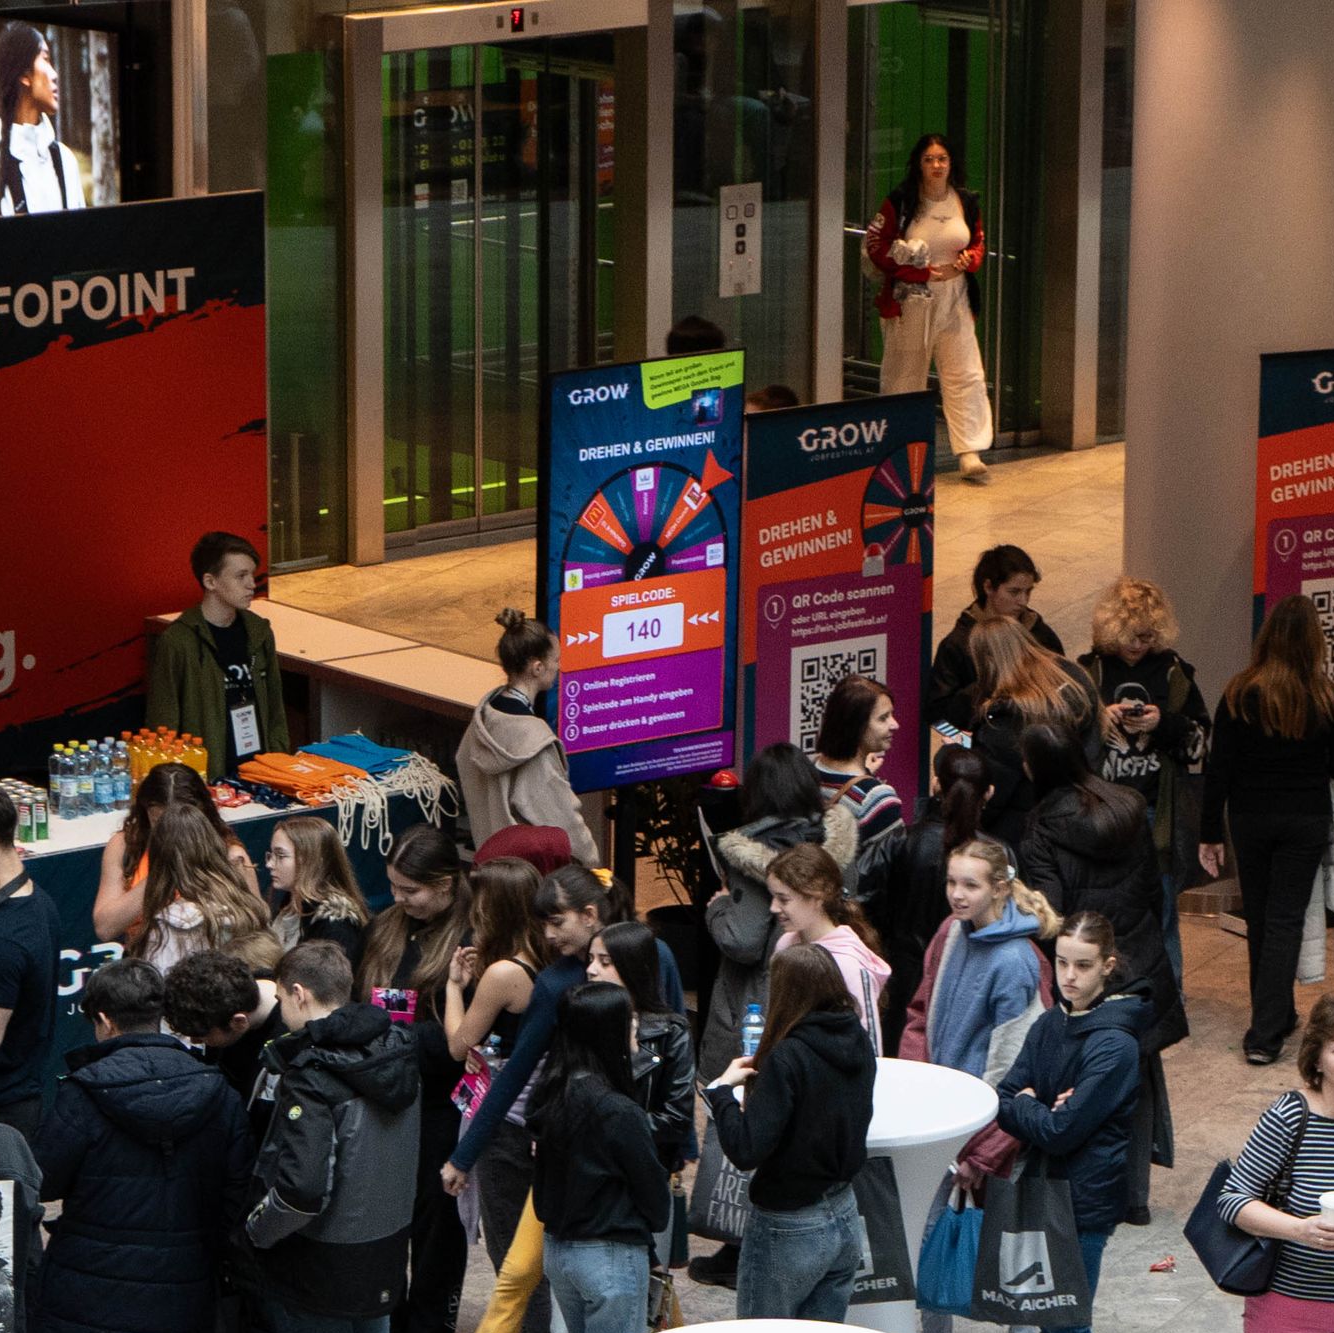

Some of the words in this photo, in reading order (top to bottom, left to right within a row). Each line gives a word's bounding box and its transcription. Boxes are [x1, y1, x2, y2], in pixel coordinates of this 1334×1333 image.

[568, 383, 629, 405] GROW
[579, 443, 631, 462] DREHEN
[633, 441, 643, 454] &
[645, 430, 716, 452] GEWINNEN!
[798, 419, 888, 452] GROW
[759, 513, 822, 545] DREHEN
[826, 510, 837, 526] &
[1303, 530, 1322, 544] QR
[760, 529, 853, 568] GEWINNEN!
[611, 587, 676, 607] SPIELCODE:
[792, 594, 810, 609] QR
[813, 590, 845, 605] Code
[847, 584, 895, 600] scannen
[791, 613, 811, 625] oder
[812, 610, 828, 622] URL
[830, 607, 866, 621] eingeben
[627, 618, 662, 642] 140
[583, 680, 609, 691] Online
[610, 672, 656, 688] Registrieren
[582, 699, 619, 713] Spielcode
[620, 697, 633, 706] am
[633, 692, 658, 705] Handy
[659, 687, 694, 701] eingeben
[582, 723, 608, 735] Buzzer
[609, 716, 641, 730] drücken
[648, 710, 686, 725] gewinnen
[711, 1172, 748, 1207] ARE
[707, 1200, 748, 1237] FAMI
[853, 1276, 898, 1292] CHER
[982, 1289, 1016, 1310] MAX
[1020, 1294, 1078, 1311] AICHER
